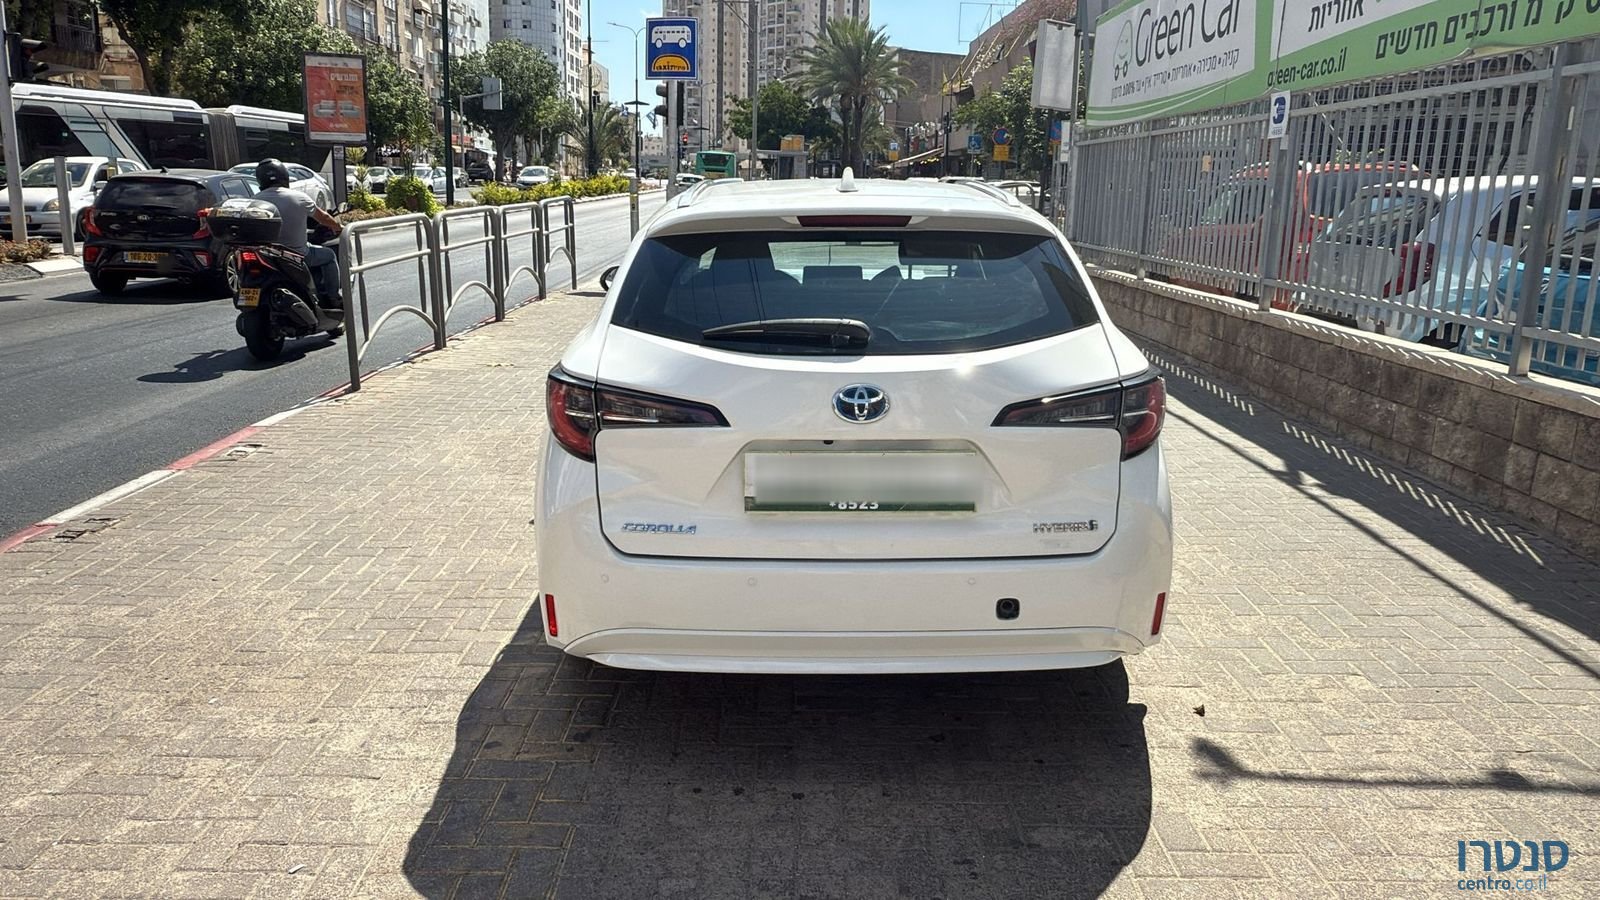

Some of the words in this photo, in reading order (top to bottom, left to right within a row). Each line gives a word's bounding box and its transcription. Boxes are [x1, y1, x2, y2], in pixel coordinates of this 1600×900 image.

[1135, 2, 1195, 67] Green
[1201, 0, 1240, 43] Car
[1375, 21, 1438, 60] חדשים
[1443, 0, 1518, 44] ורכבים
[1222, 48, 1240, 70] קניה
[621, 522, 697, 535] COROLLA
